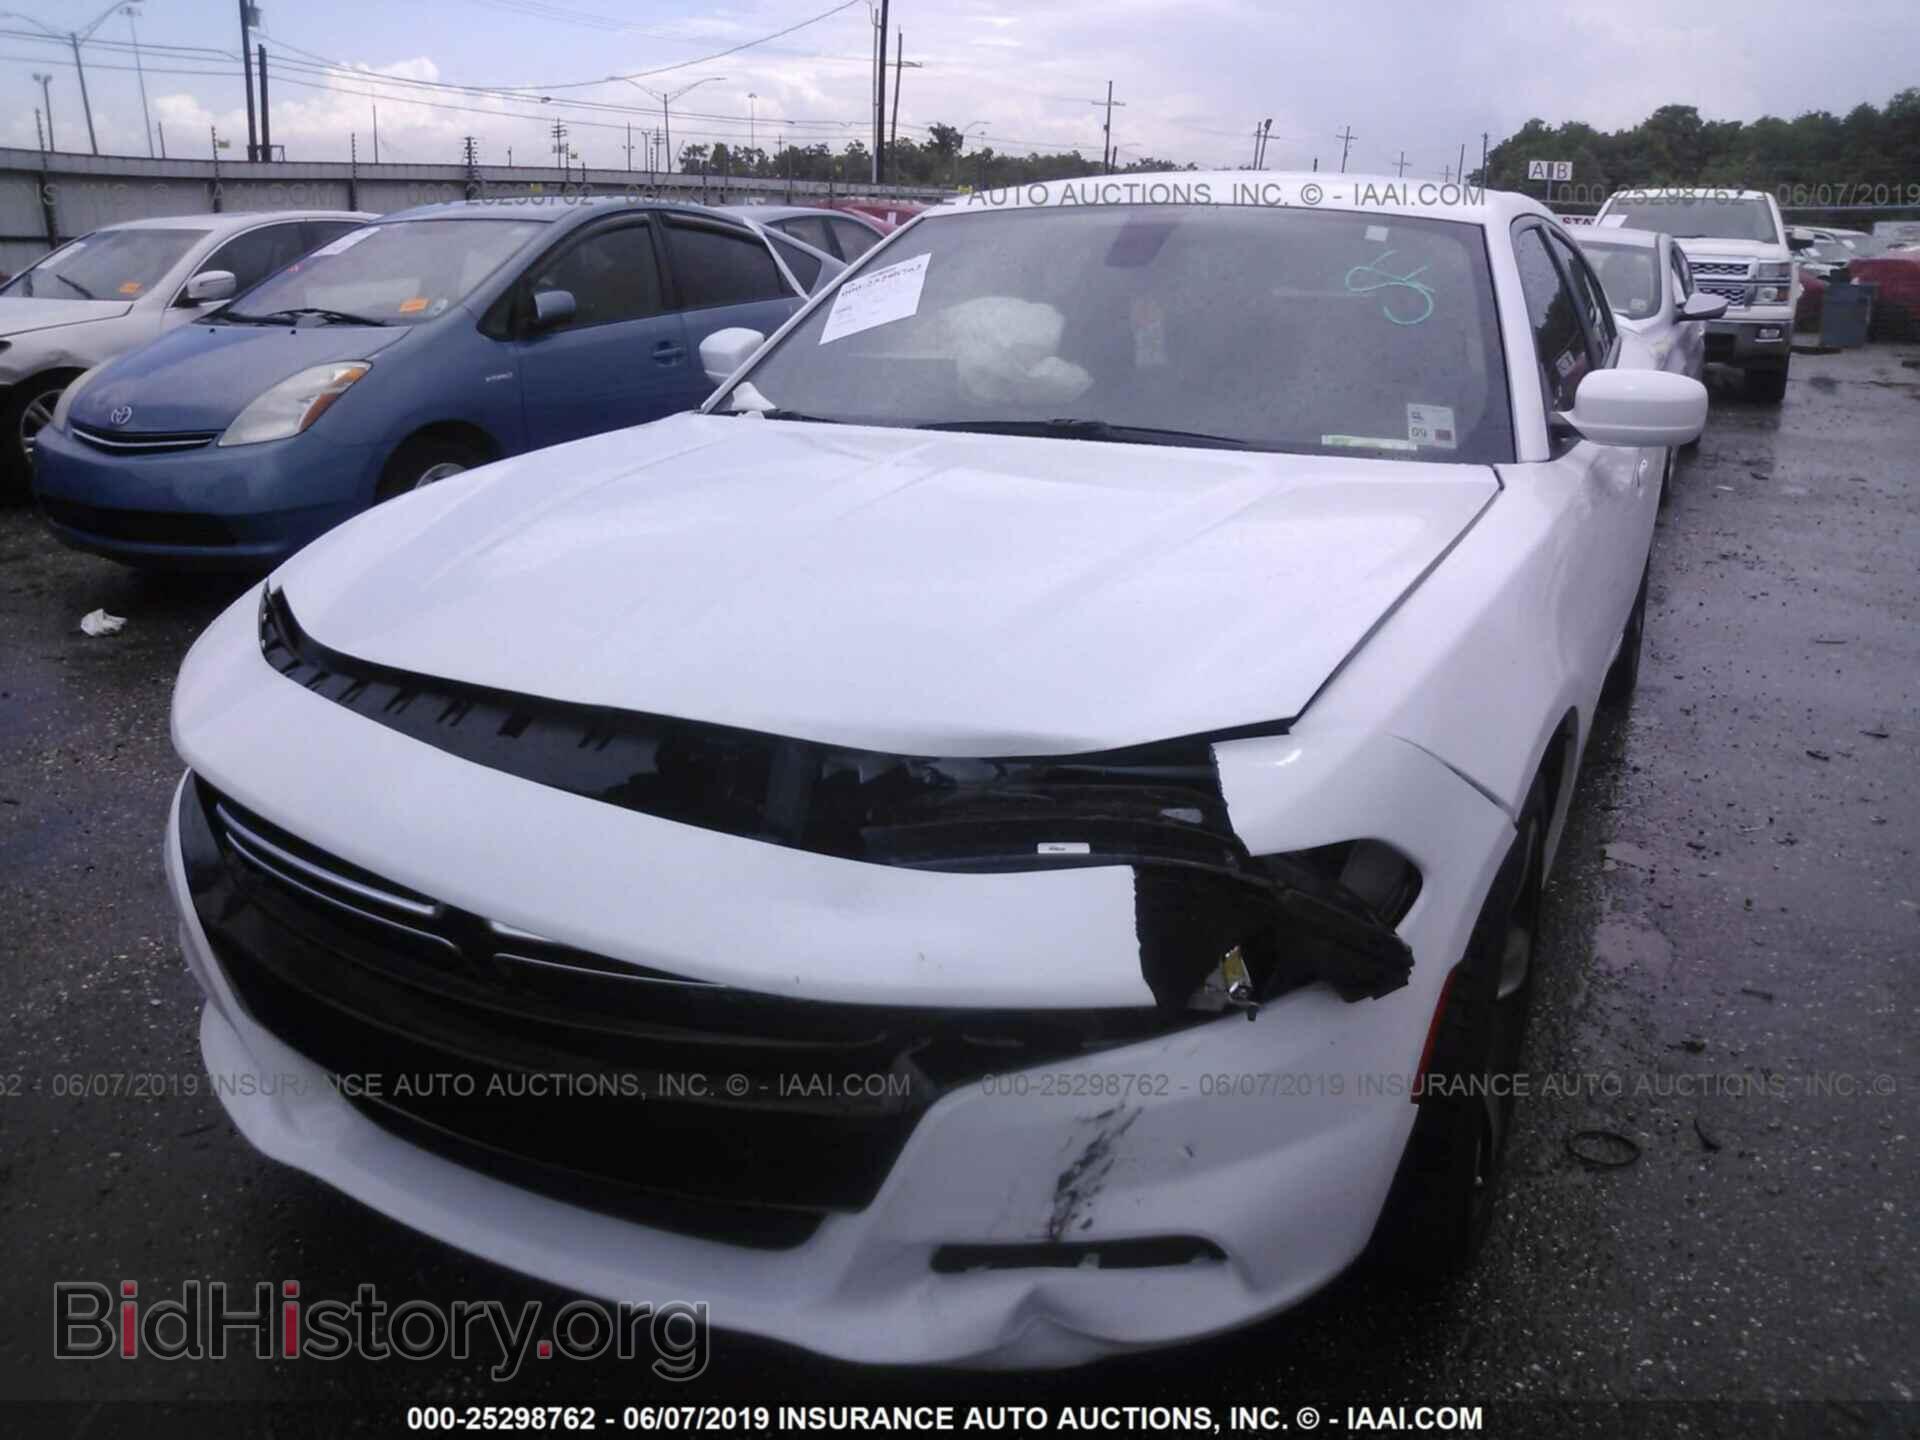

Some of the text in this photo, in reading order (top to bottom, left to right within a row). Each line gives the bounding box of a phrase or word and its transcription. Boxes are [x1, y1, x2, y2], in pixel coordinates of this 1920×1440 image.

[1532, 162, 1568, 179] A B
[1563, 217, 1596, 225] STA
